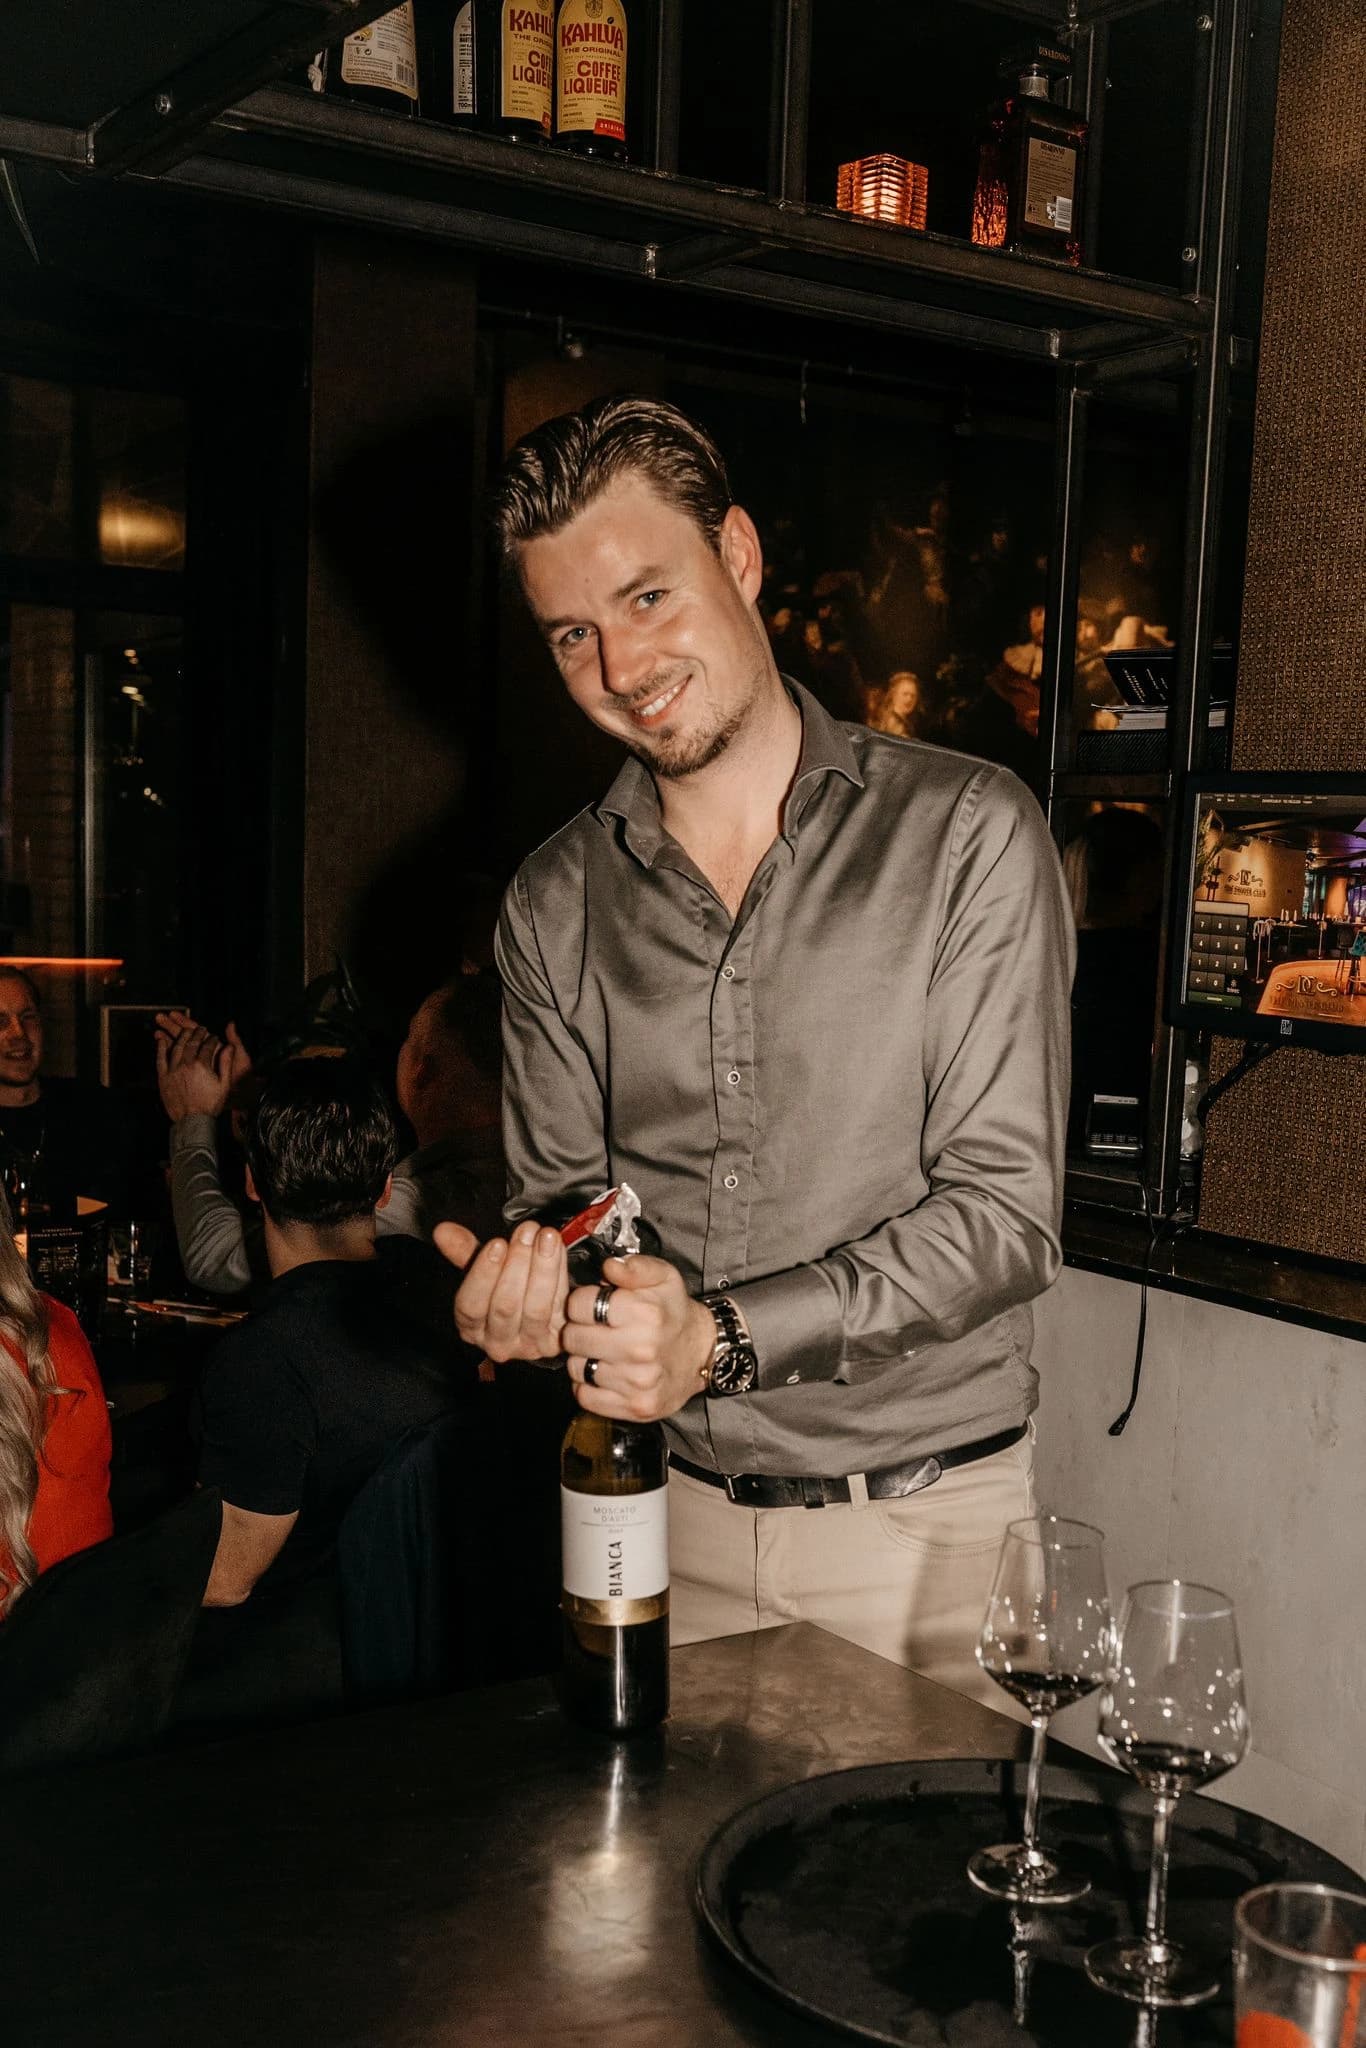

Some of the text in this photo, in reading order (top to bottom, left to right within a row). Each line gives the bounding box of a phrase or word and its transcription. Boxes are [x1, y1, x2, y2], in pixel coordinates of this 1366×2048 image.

[513, 33, 531, 41] THE
[564, 46, 621, 58] THE ORIGINAL
[576, 60, 621, 82] COFFEE
[563, 77, 618, 97] LIQUEUR
[592, 1506, 637, 1515] MOSCATO
[608, 1541, 623, 1597] BIANCA
